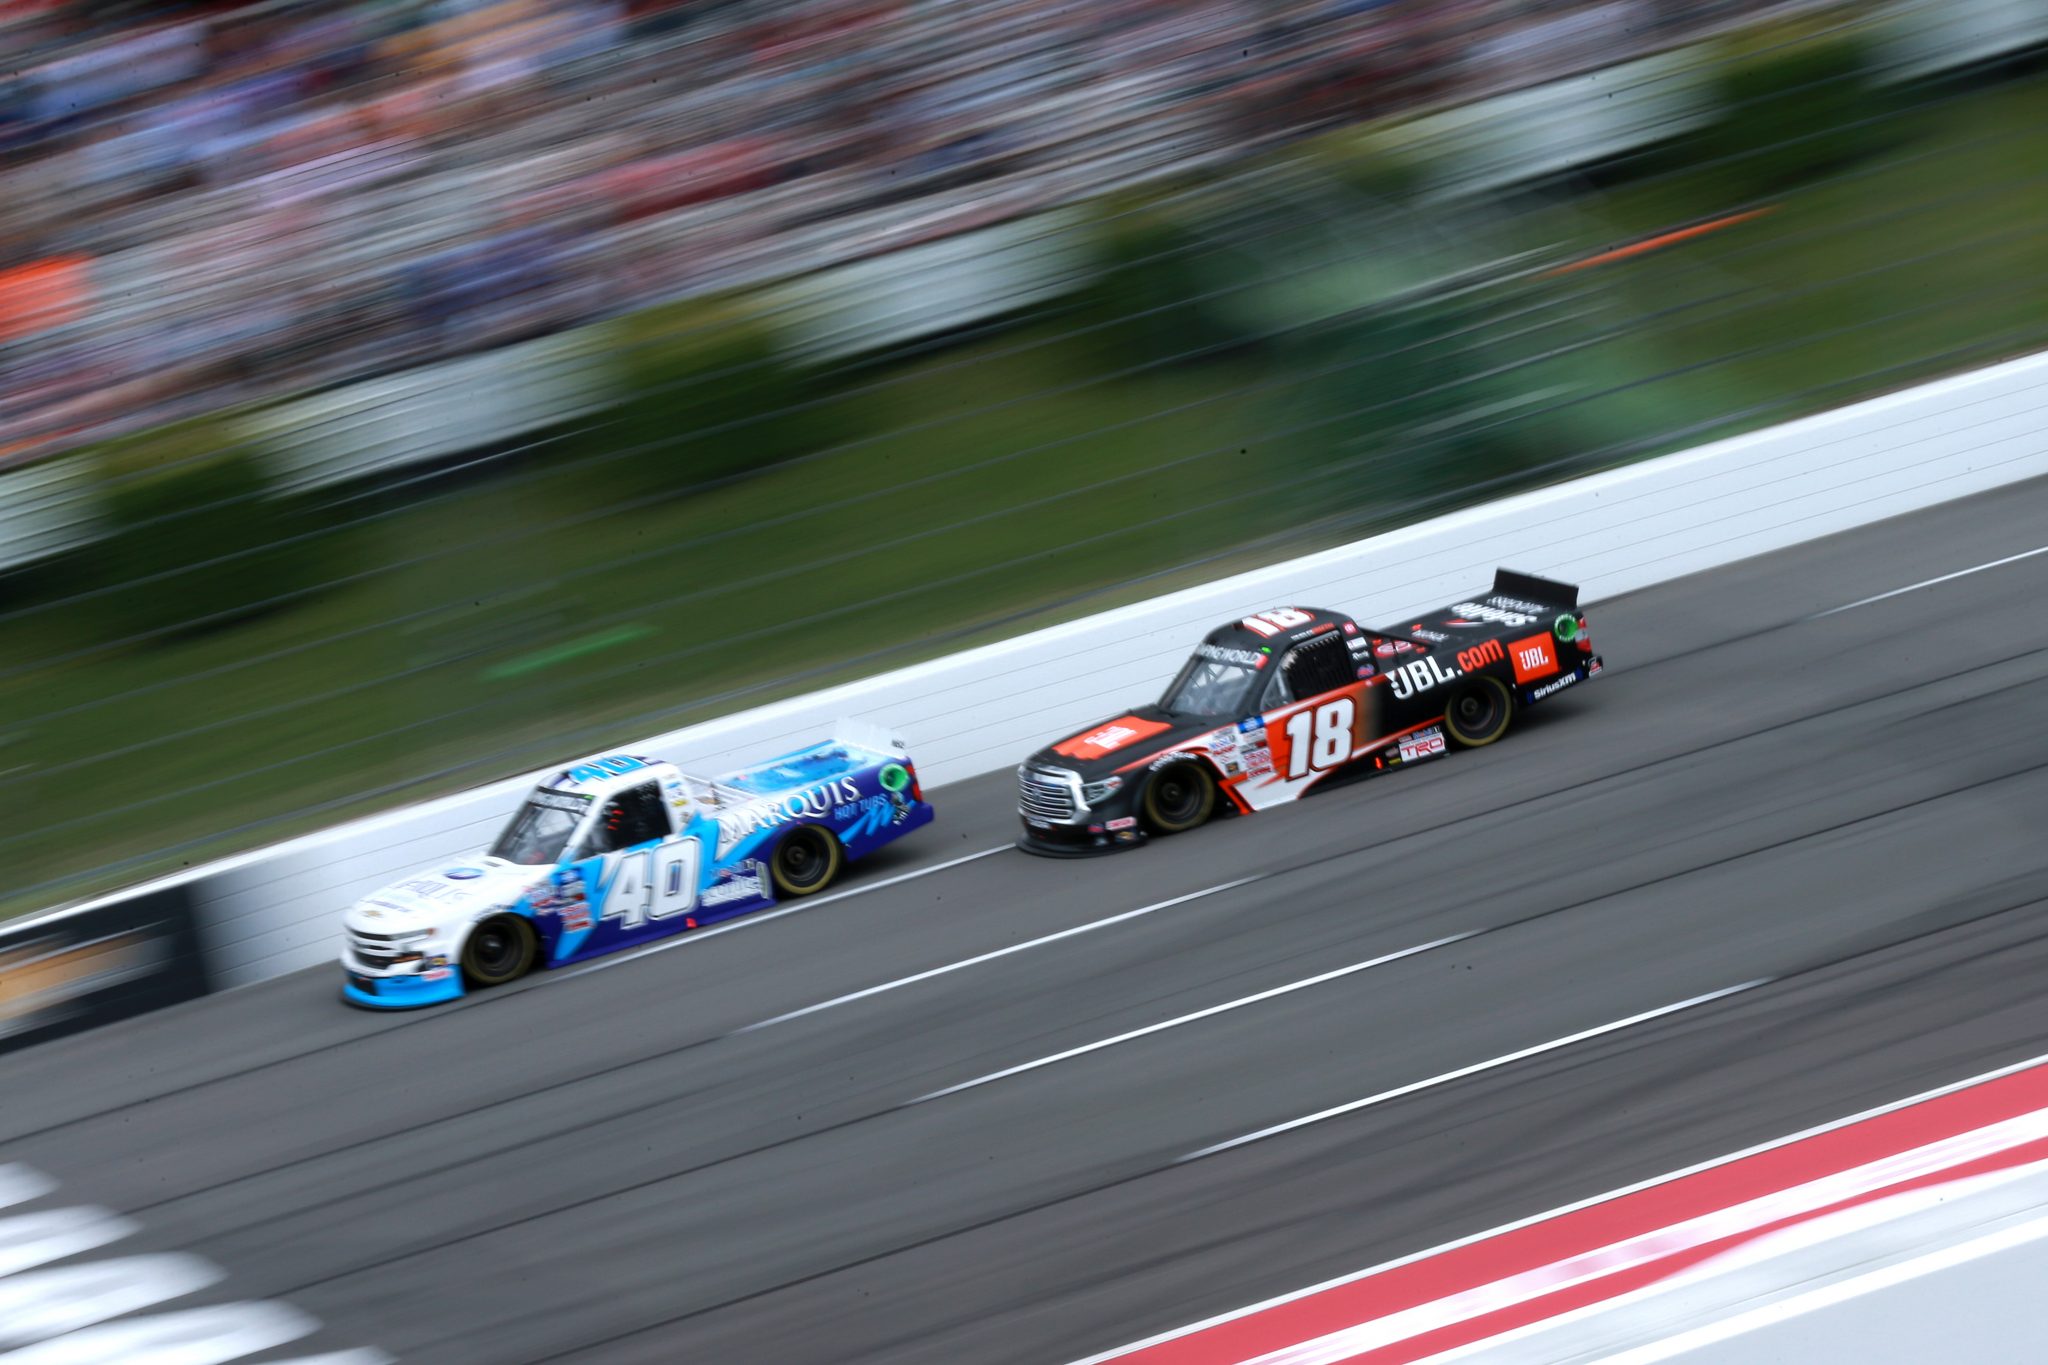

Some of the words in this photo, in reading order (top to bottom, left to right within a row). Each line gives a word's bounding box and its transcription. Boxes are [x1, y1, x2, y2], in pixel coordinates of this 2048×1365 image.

[1242, 607, 1315, 638] 18
[1519, 645, 1549, 671] JBL
[1286, 698, 1356, 780] 18
[1400, 738, 1445, 758] TRD
[715, 776, 861, 844] MARQUIS
[602, 836, 701, 929] 40
